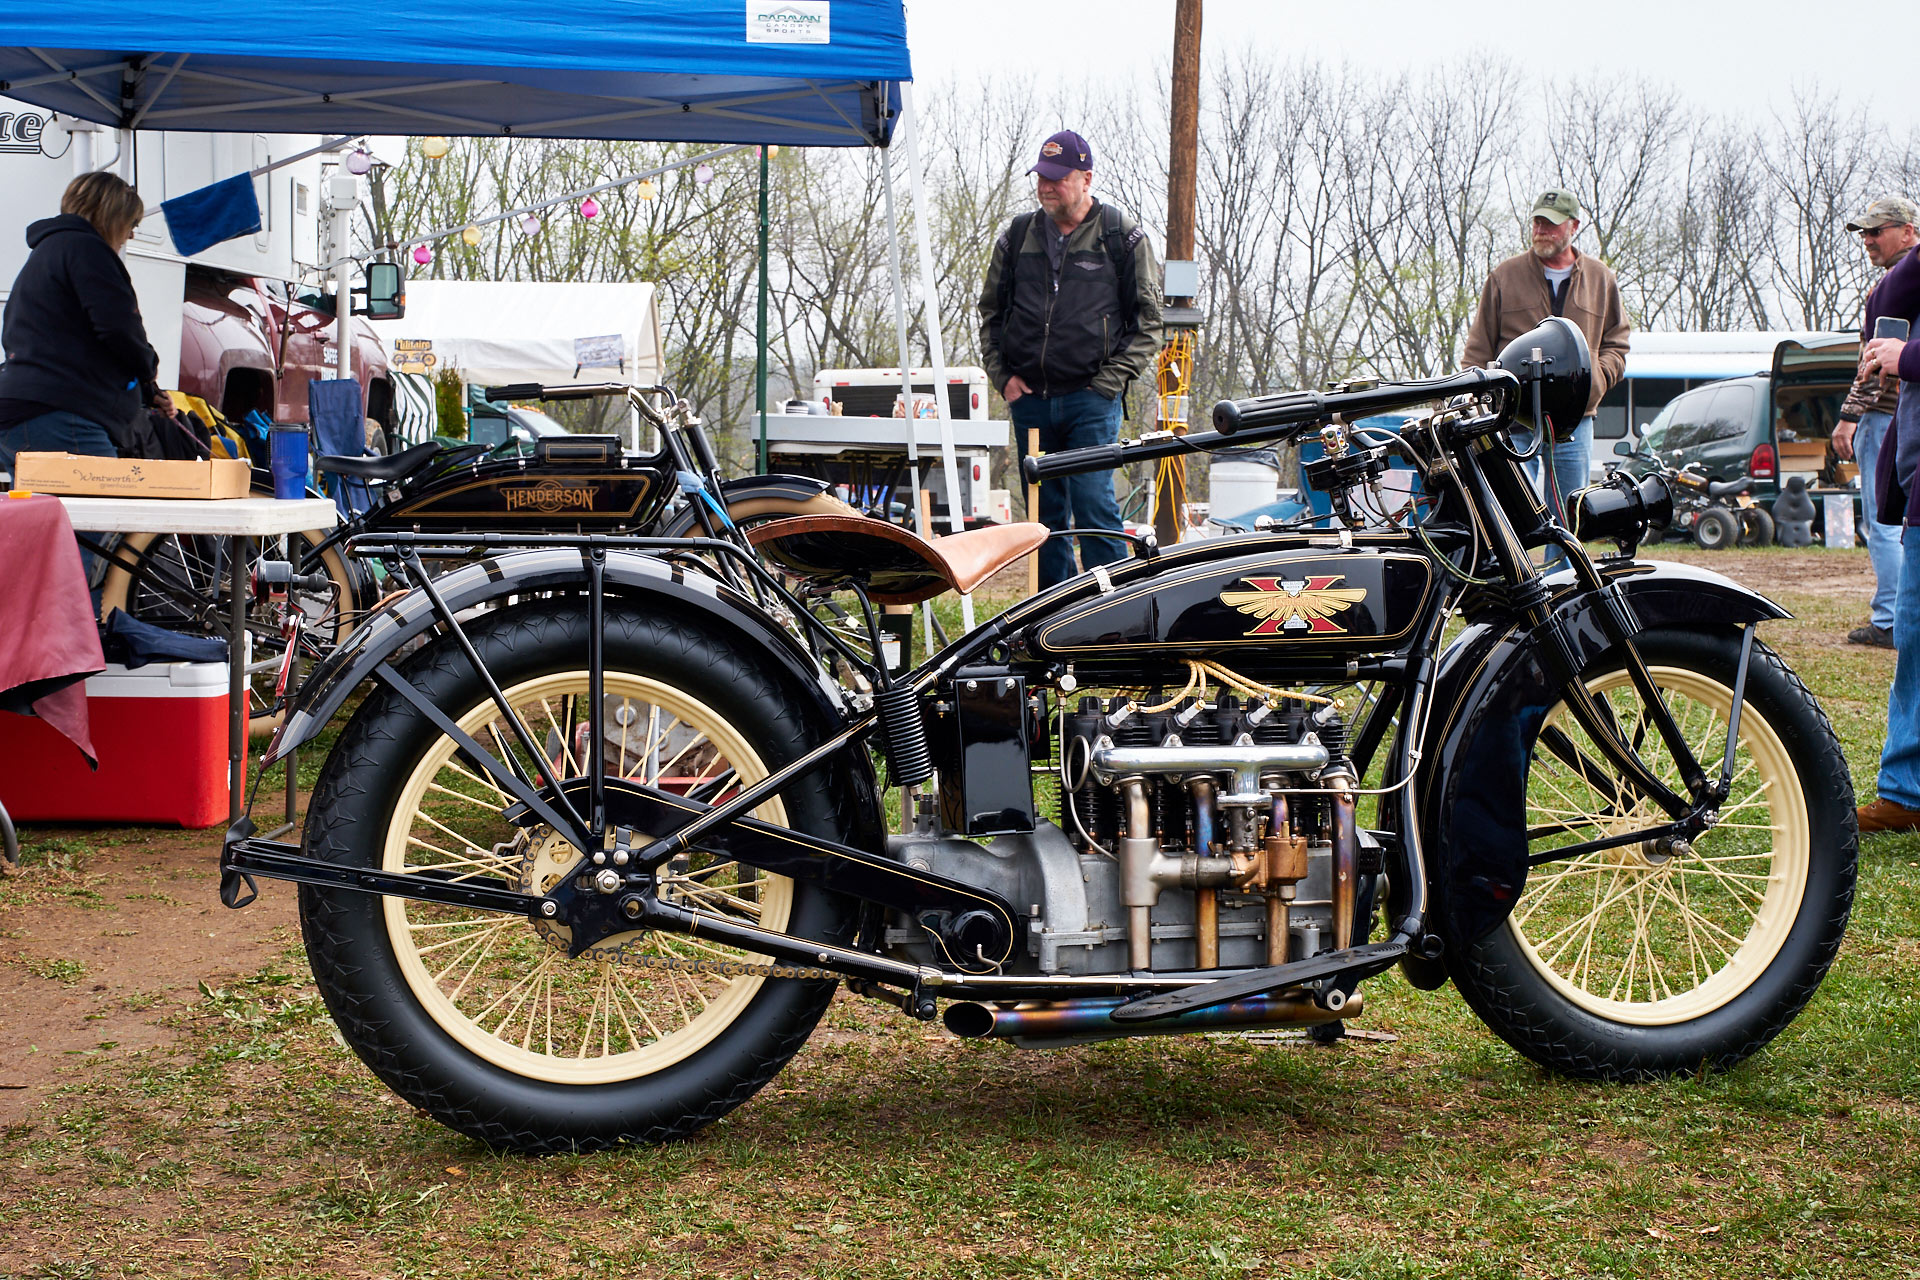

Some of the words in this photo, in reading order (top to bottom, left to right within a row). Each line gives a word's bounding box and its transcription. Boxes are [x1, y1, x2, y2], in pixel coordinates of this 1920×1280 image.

[758, 14, 822, 23] CARAVAN
[73, 469, 131, 483] Wentworth
[506, 489, 593, 511] HENDERSON
[1266, 596, 1323, 613] HENDERSON
